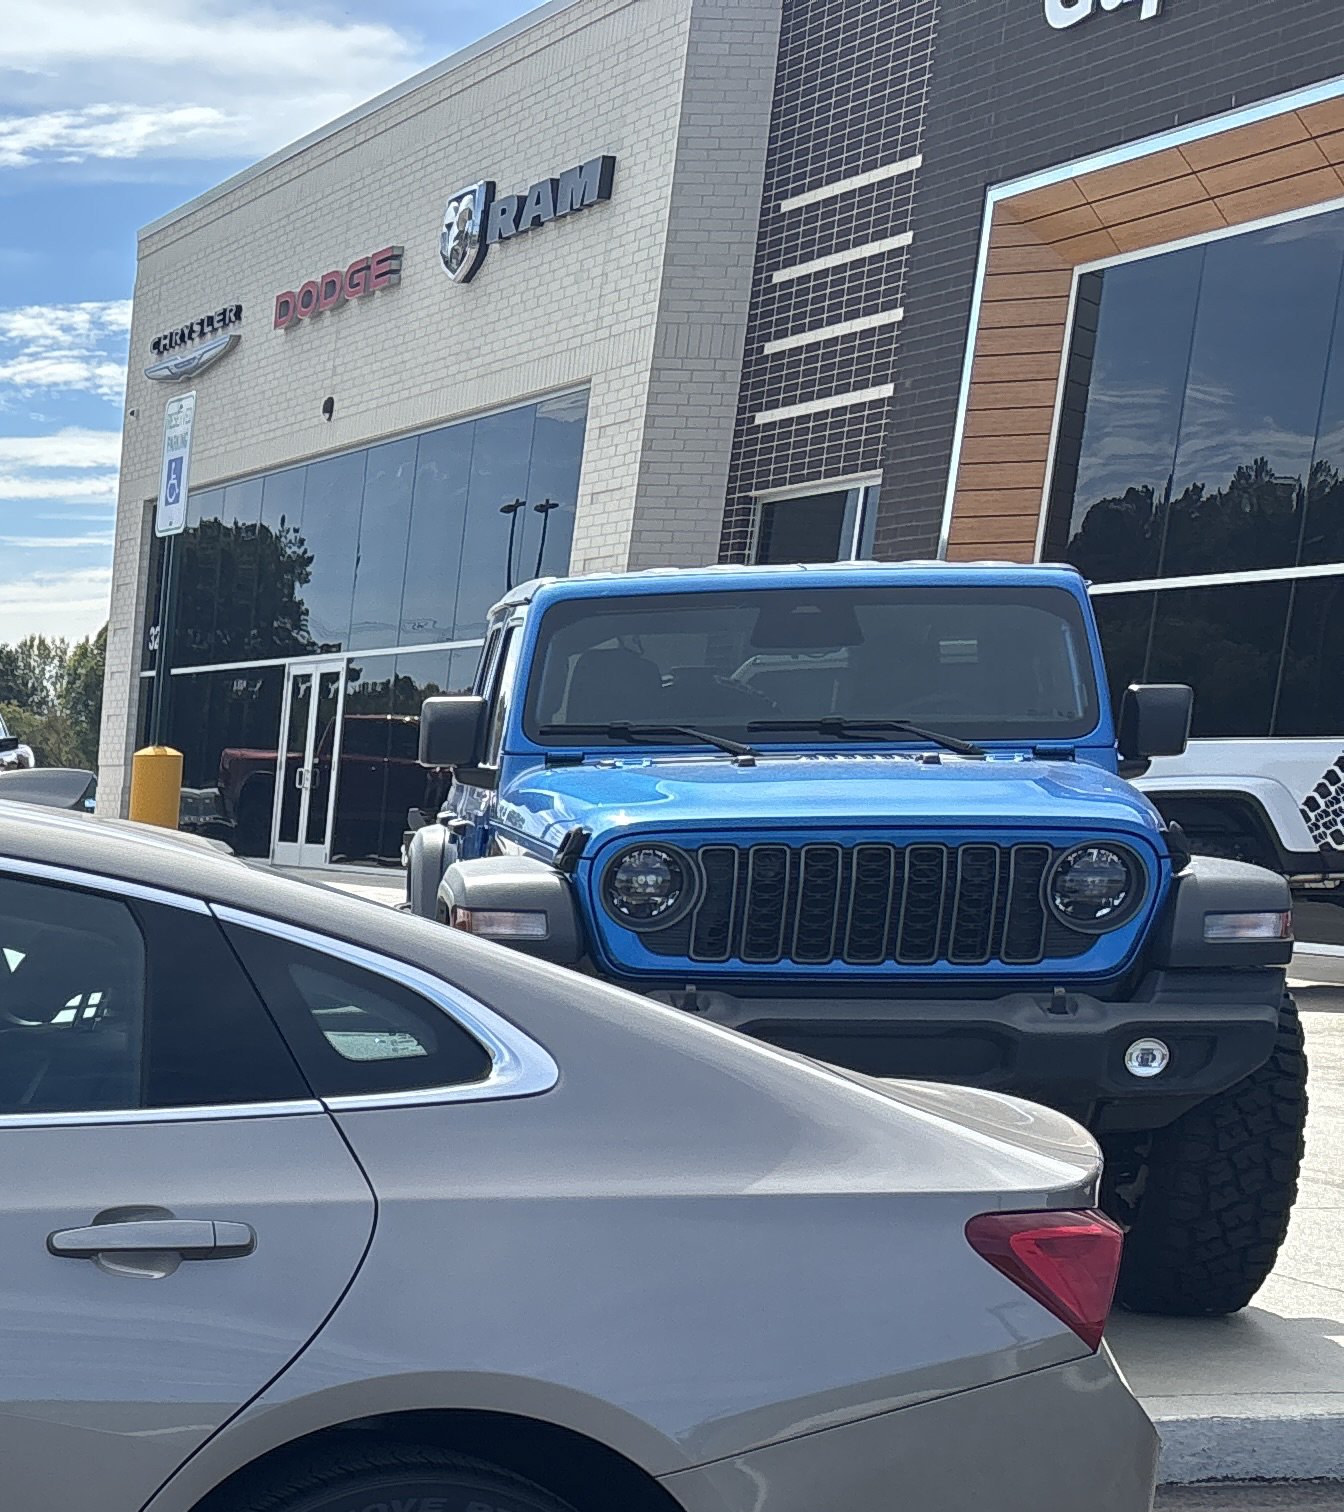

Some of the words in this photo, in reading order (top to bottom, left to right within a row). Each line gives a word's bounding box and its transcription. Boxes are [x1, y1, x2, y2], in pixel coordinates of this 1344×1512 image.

[487, 155, 616, 244] RAM
[149, 303, 243, 356] CHRYSLER
[273, 245, 404, 330] DODGE
